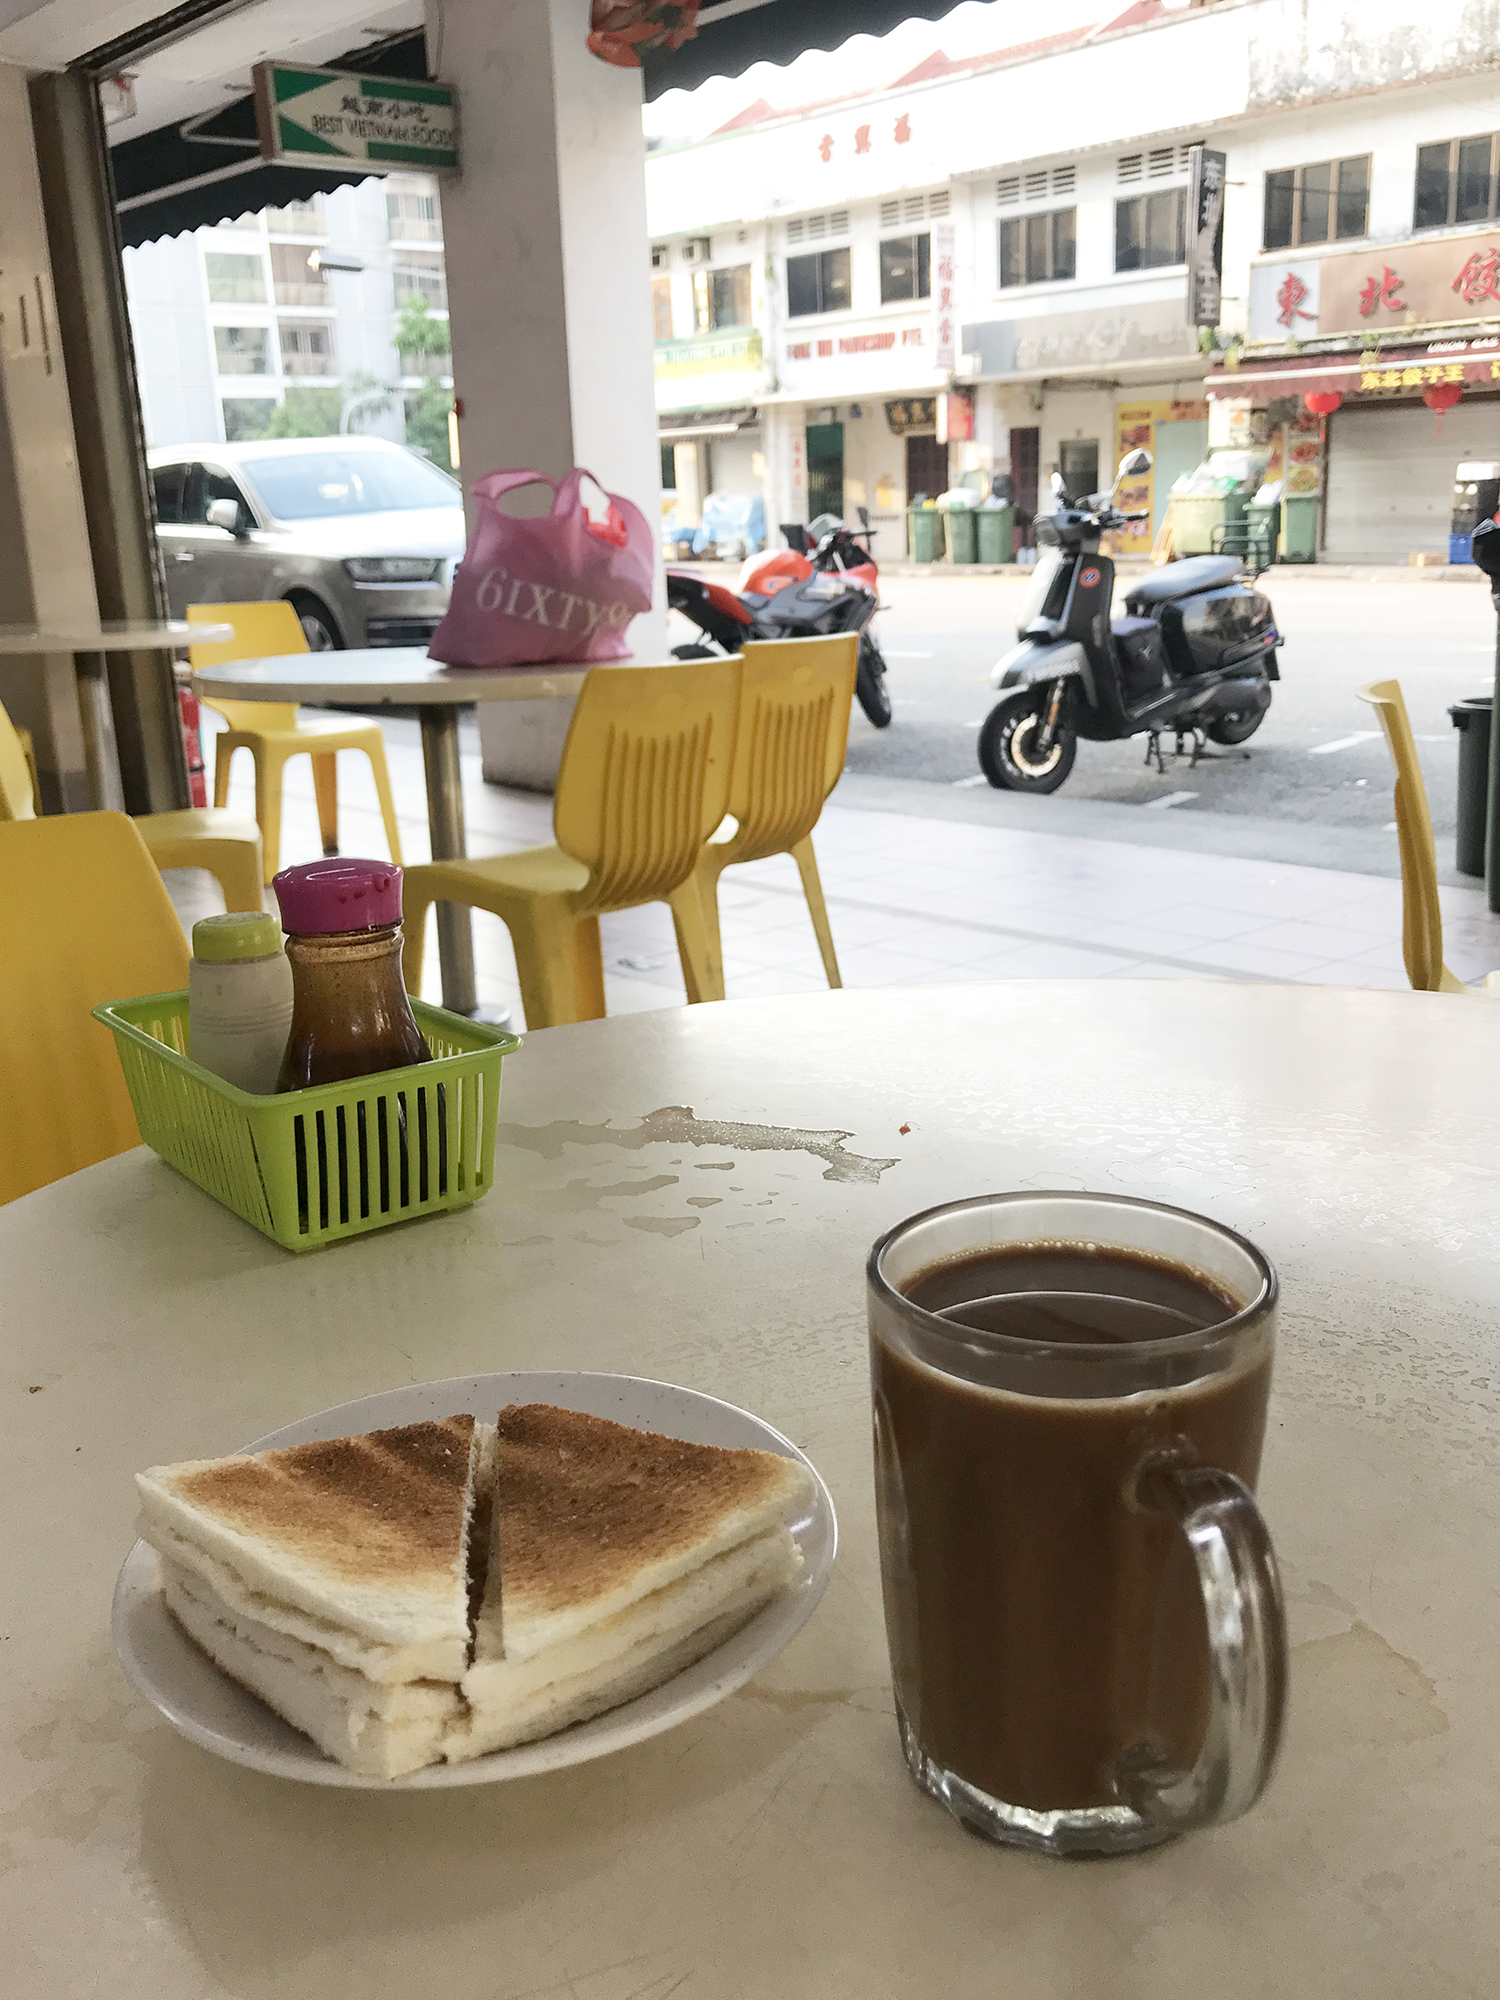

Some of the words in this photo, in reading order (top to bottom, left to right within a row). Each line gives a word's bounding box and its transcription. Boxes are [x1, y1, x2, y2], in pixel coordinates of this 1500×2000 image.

[311, 114, 344, 135] BEST
[349, 118, 409, 141] VIETNAM
[1427, 340, 1468, 353] UNION
[1471, 336, 1499, 349] GAS
